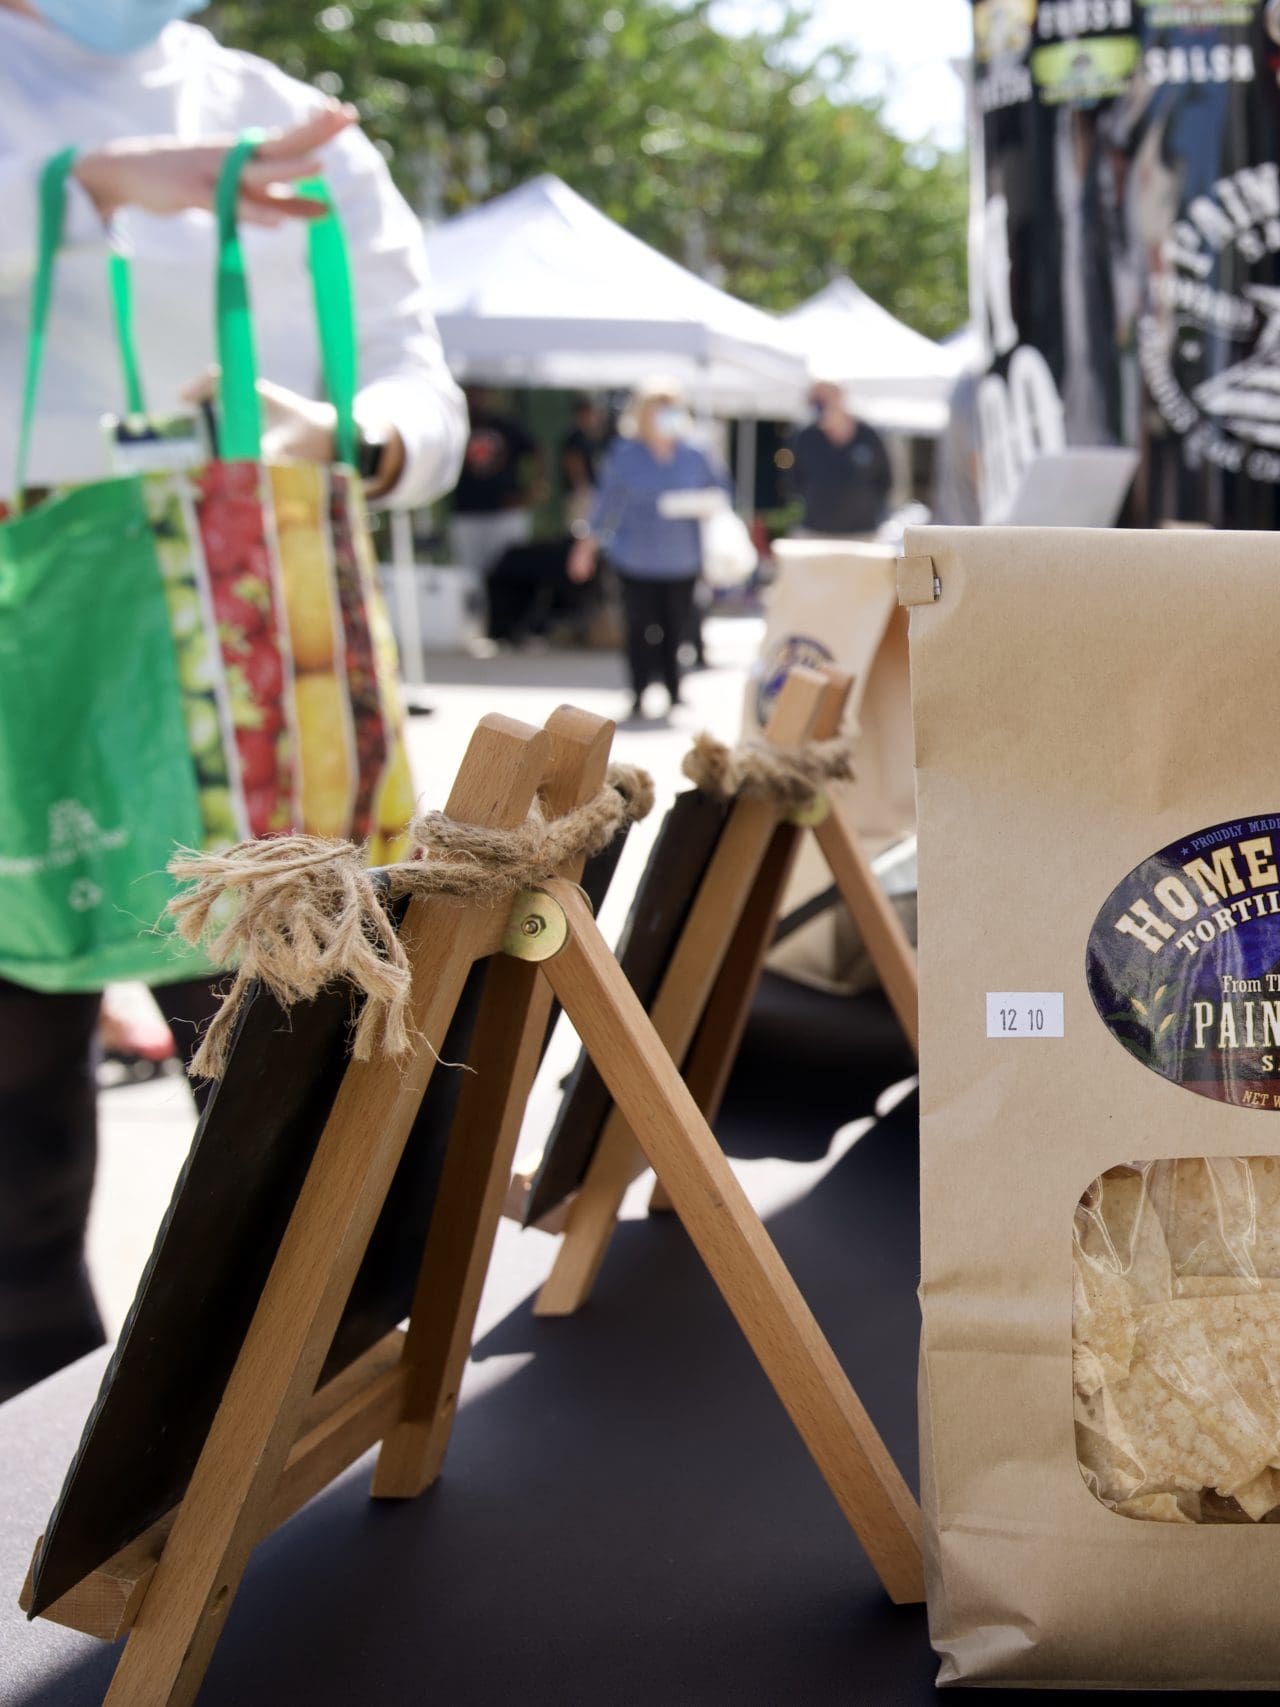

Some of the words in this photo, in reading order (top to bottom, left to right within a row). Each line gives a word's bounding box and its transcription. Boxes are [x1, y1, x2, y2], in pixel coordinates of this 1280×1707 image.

[1145, 44, 1256, 86] SALSA
[1190, 825, 1243, 852] PROUDLY
[1114, 835, 1280, 955] HOME
[1222, 974, 1263, 994] From
[1000, 1008, 1018, 1031] 12
[1027, 1008, 1044, 1031] 10
[1242, 1089, 1270, 1107] NET
